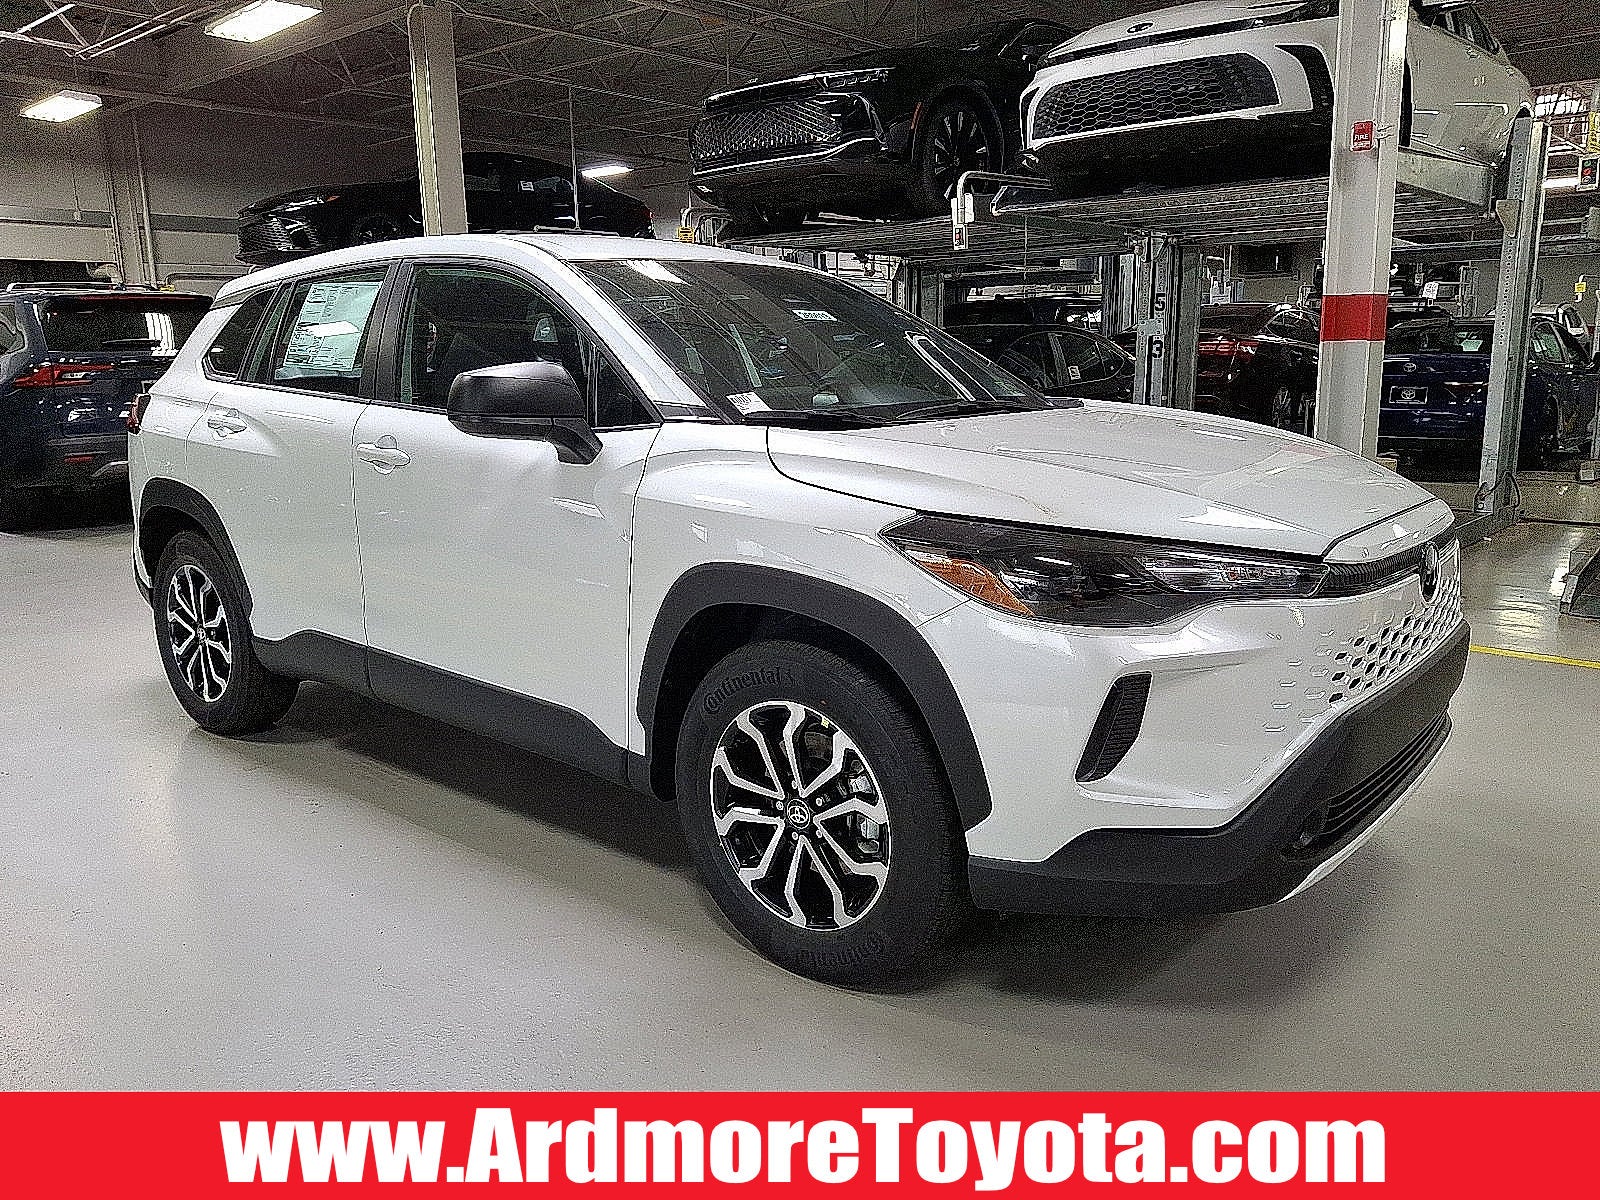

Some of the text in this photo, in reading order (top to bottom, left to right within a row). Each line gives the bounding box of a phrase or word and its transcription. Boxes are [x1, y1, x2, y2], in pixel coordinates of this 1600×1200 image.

[1353, 133, 1369, 141] FIRE
[1154, 292, 1166, 312] 5
[1152, 339, 1164, 359] 3
[703, 668, 780, 714] Continental
